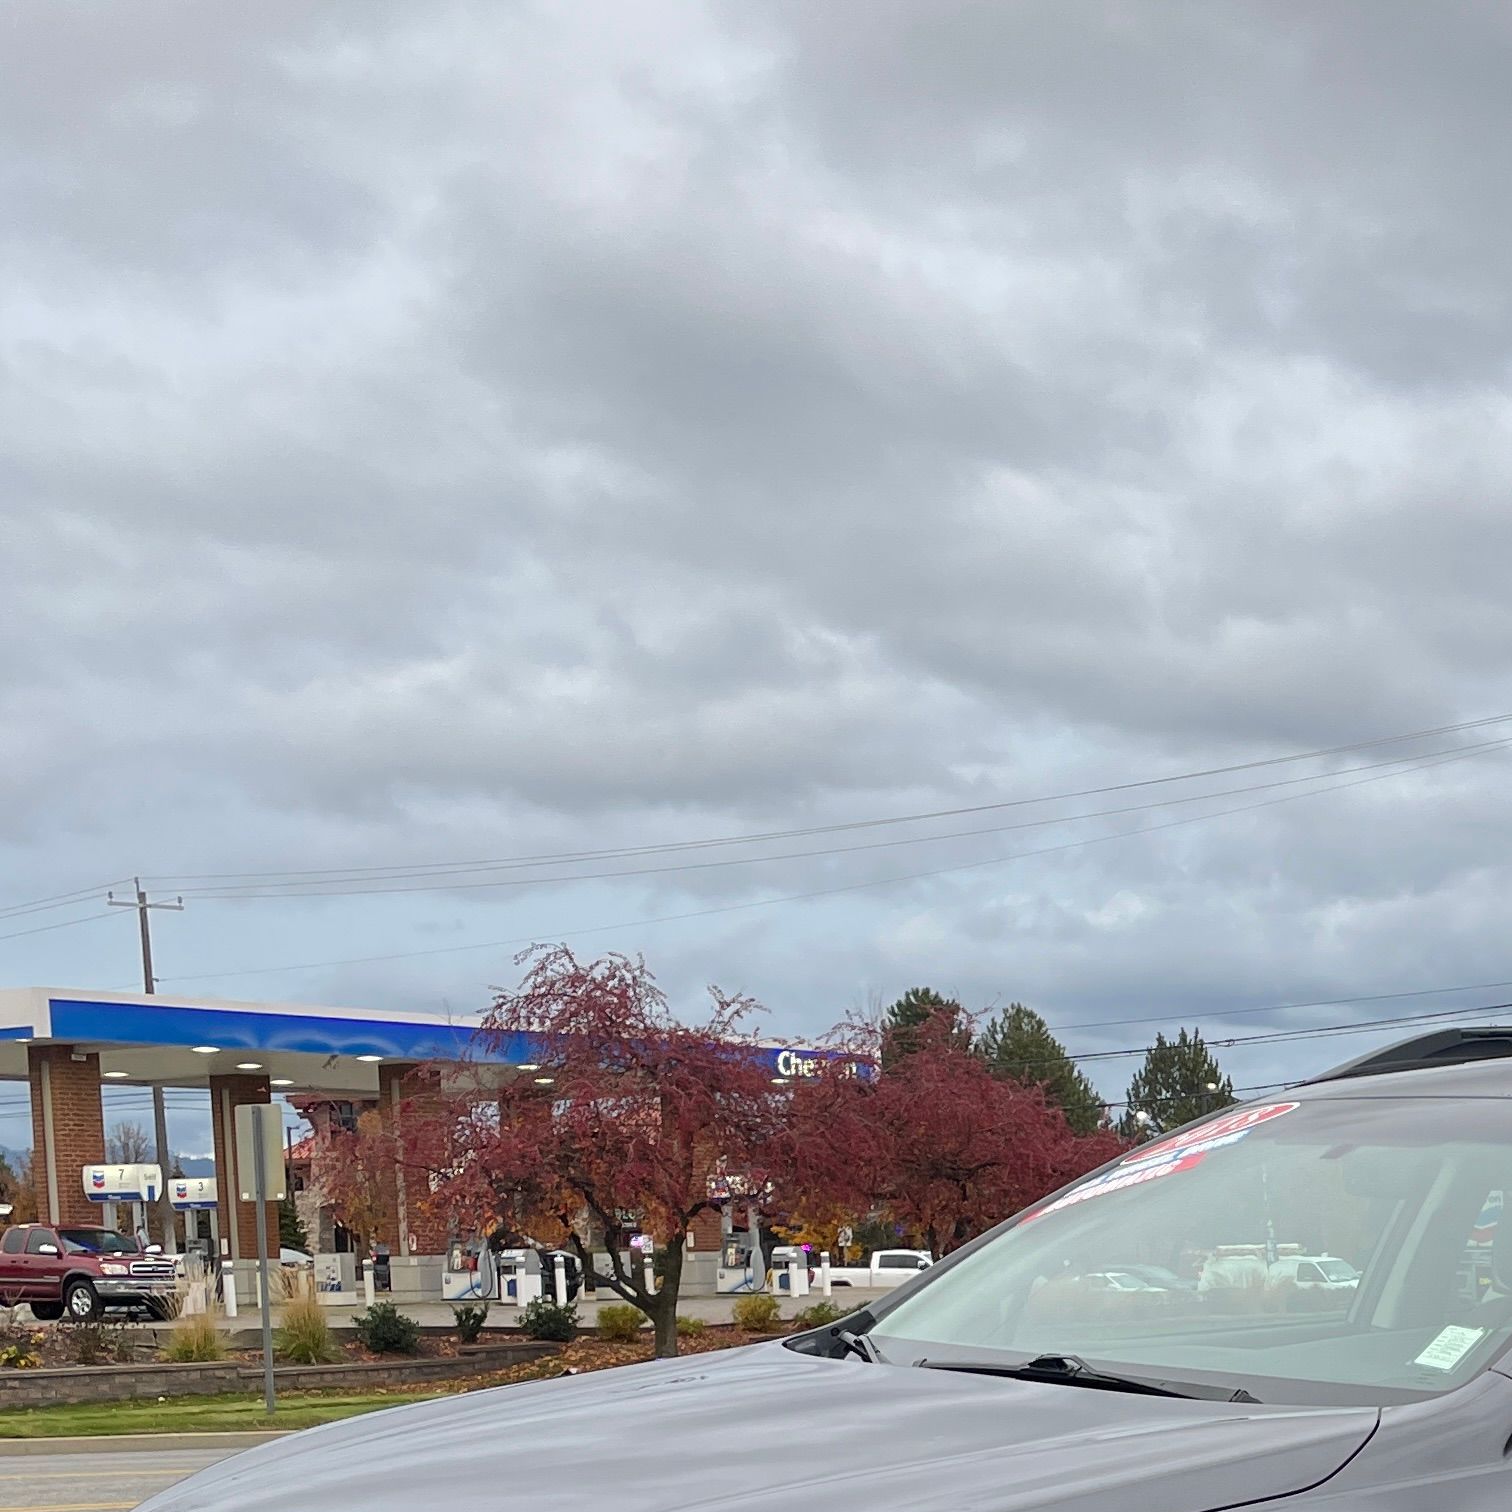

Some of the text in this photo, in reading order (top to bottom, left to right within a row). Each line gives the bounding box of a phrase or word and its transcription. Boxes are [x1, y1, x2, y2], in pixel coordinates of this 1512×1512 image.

[777, 1050, 858, 1078] Chen
[118, 1169, 125, 1181] 7
[198, 1182, 204, 1192] 3
